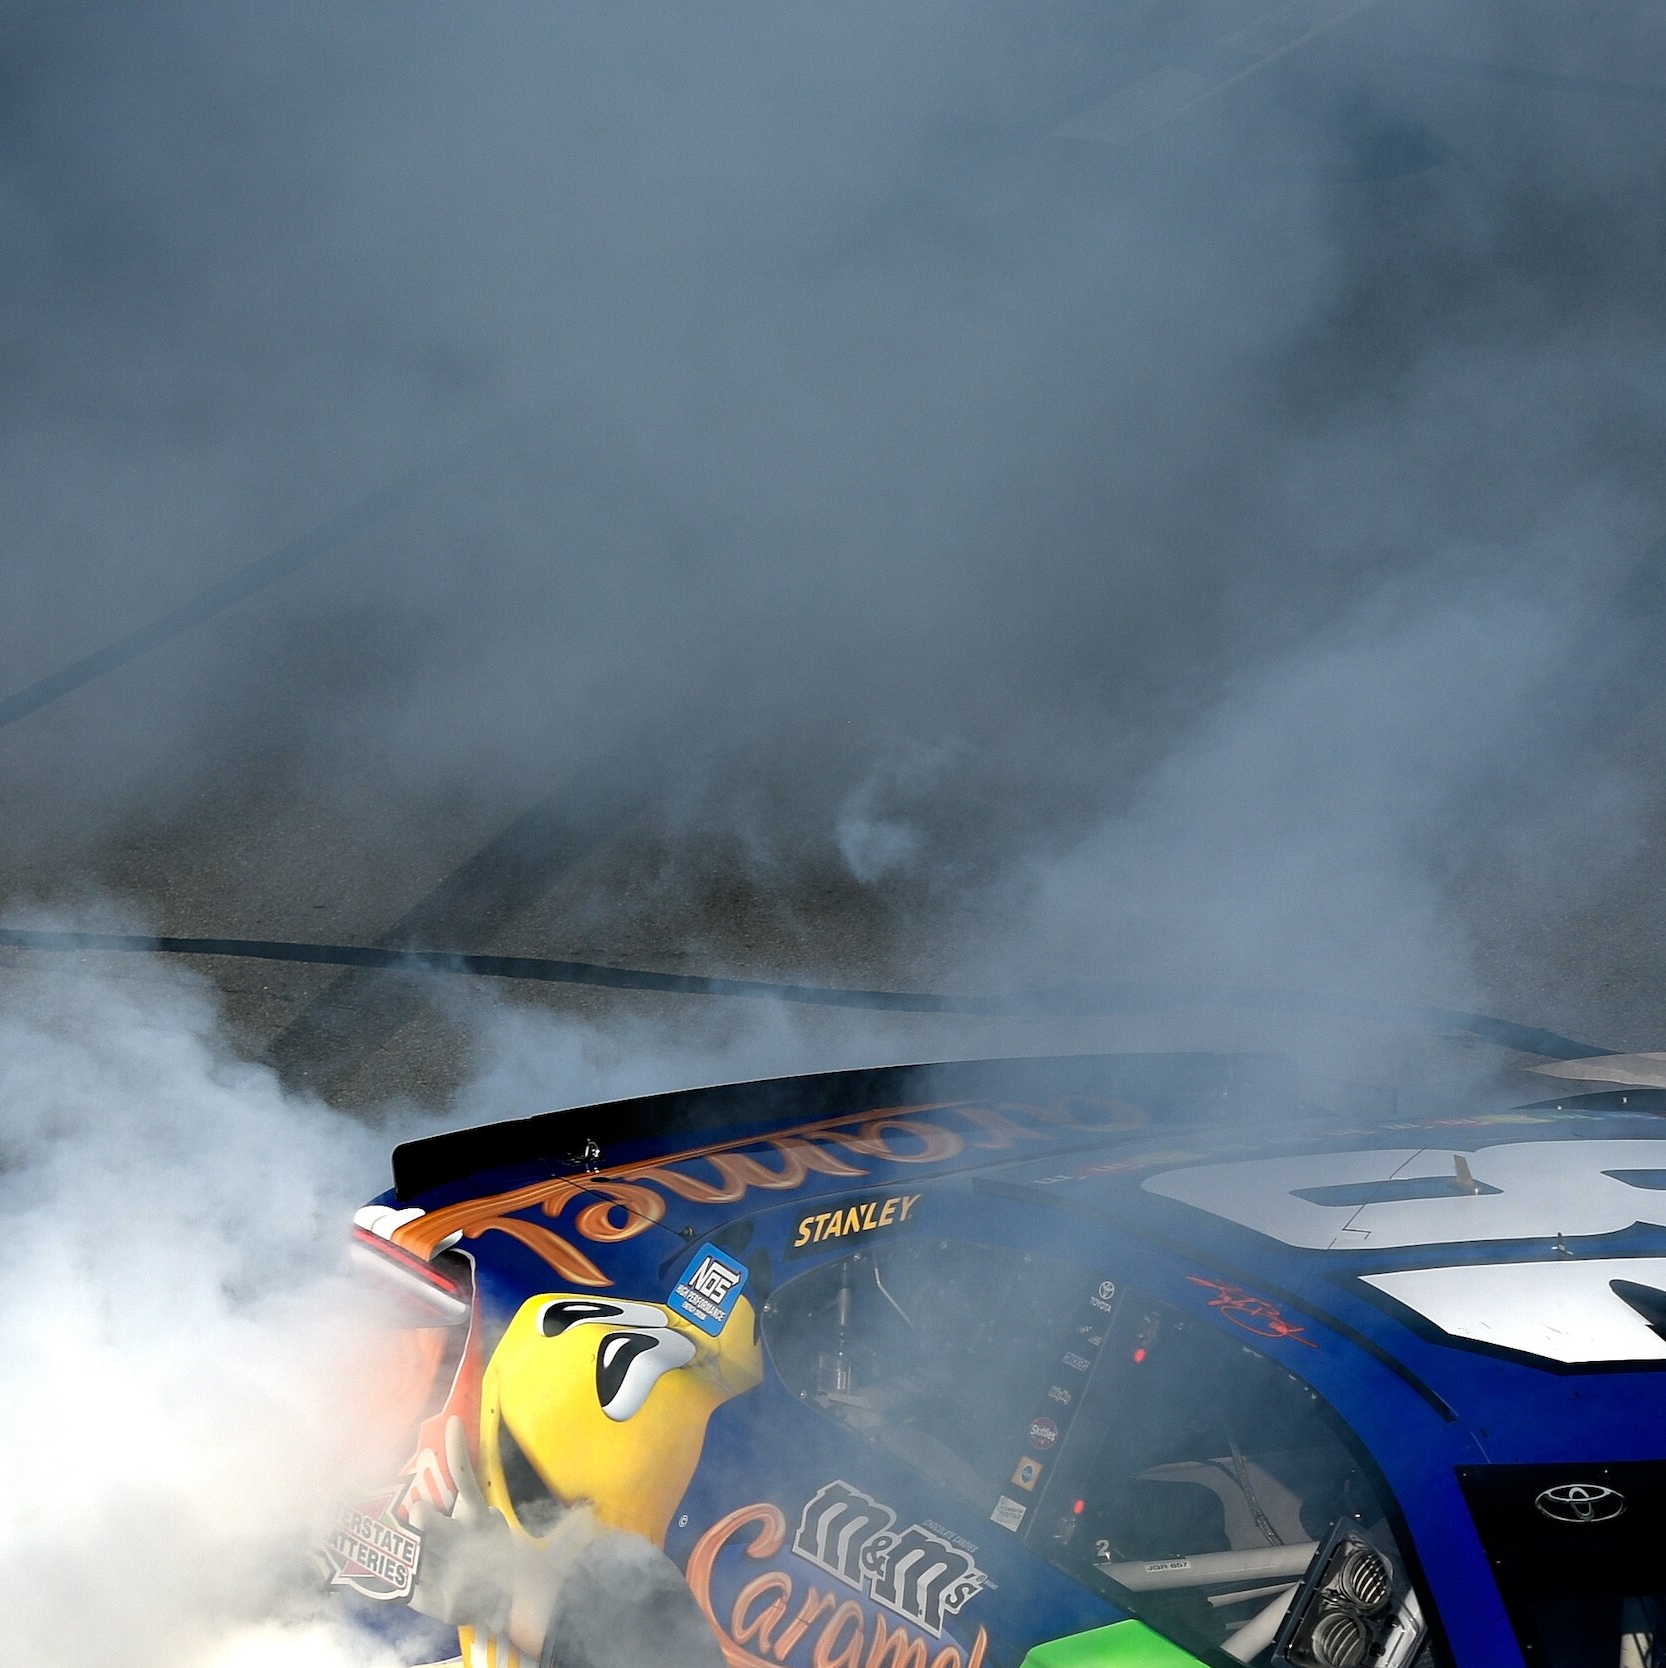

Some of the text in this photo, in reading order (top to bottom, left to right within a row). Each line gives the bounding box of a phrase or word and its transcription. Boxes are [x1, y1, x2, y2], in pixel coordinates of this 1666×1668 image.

[794, 1193, 921, 1248] STANLEY
[688, 1256, 742, 1304] NOS
[1089, 1296, 1112, 1313] TOYOTA
[1096, 1540, 1110, 1556] 2
